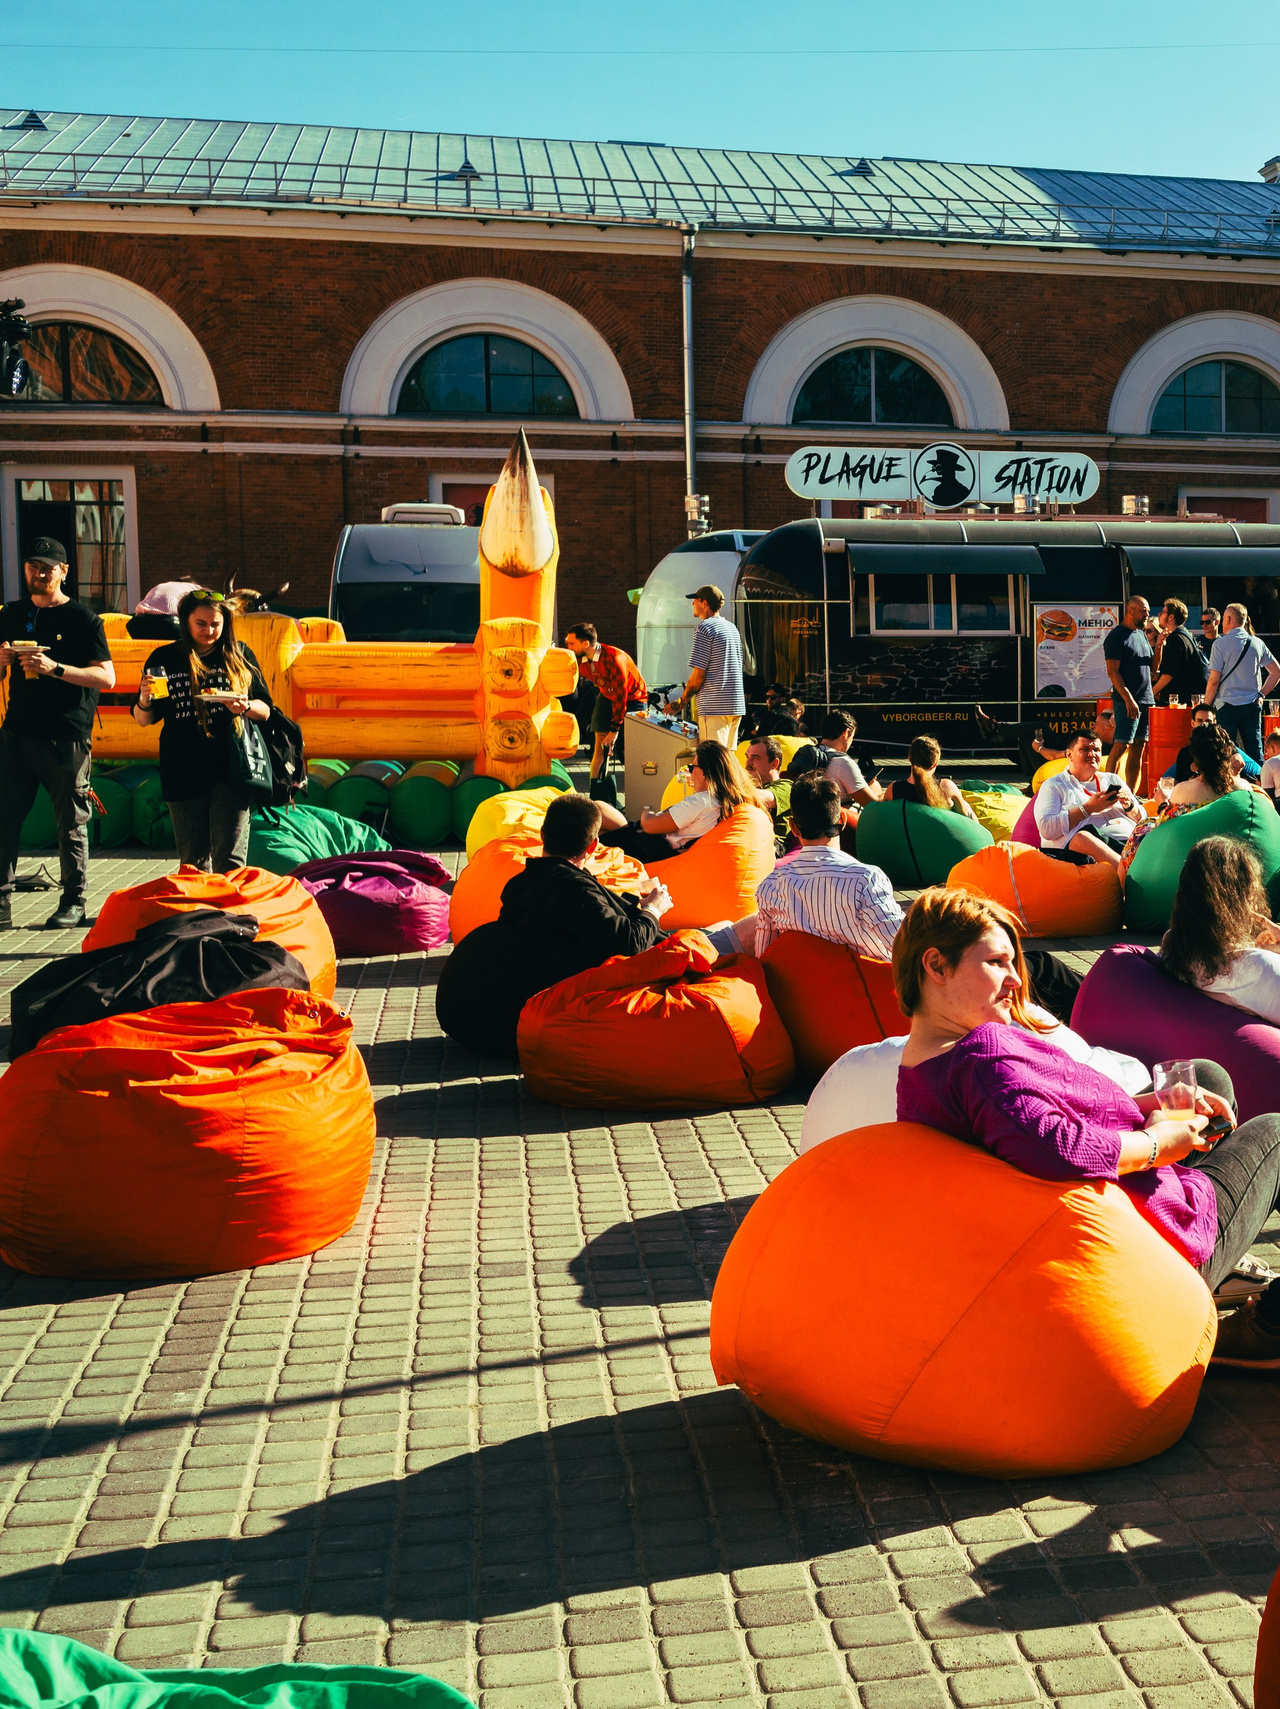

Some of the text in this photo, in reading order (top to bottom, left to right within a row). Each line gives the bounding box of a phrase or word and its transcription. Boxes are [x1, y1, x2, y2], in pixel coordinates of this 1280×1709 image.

[798, 451, 1089, 497] PLAGUE STATION
[1078, 619, 1114, 628] МЕНЮ
[881, 712, 969, 721] VYBORGBEER.RU
